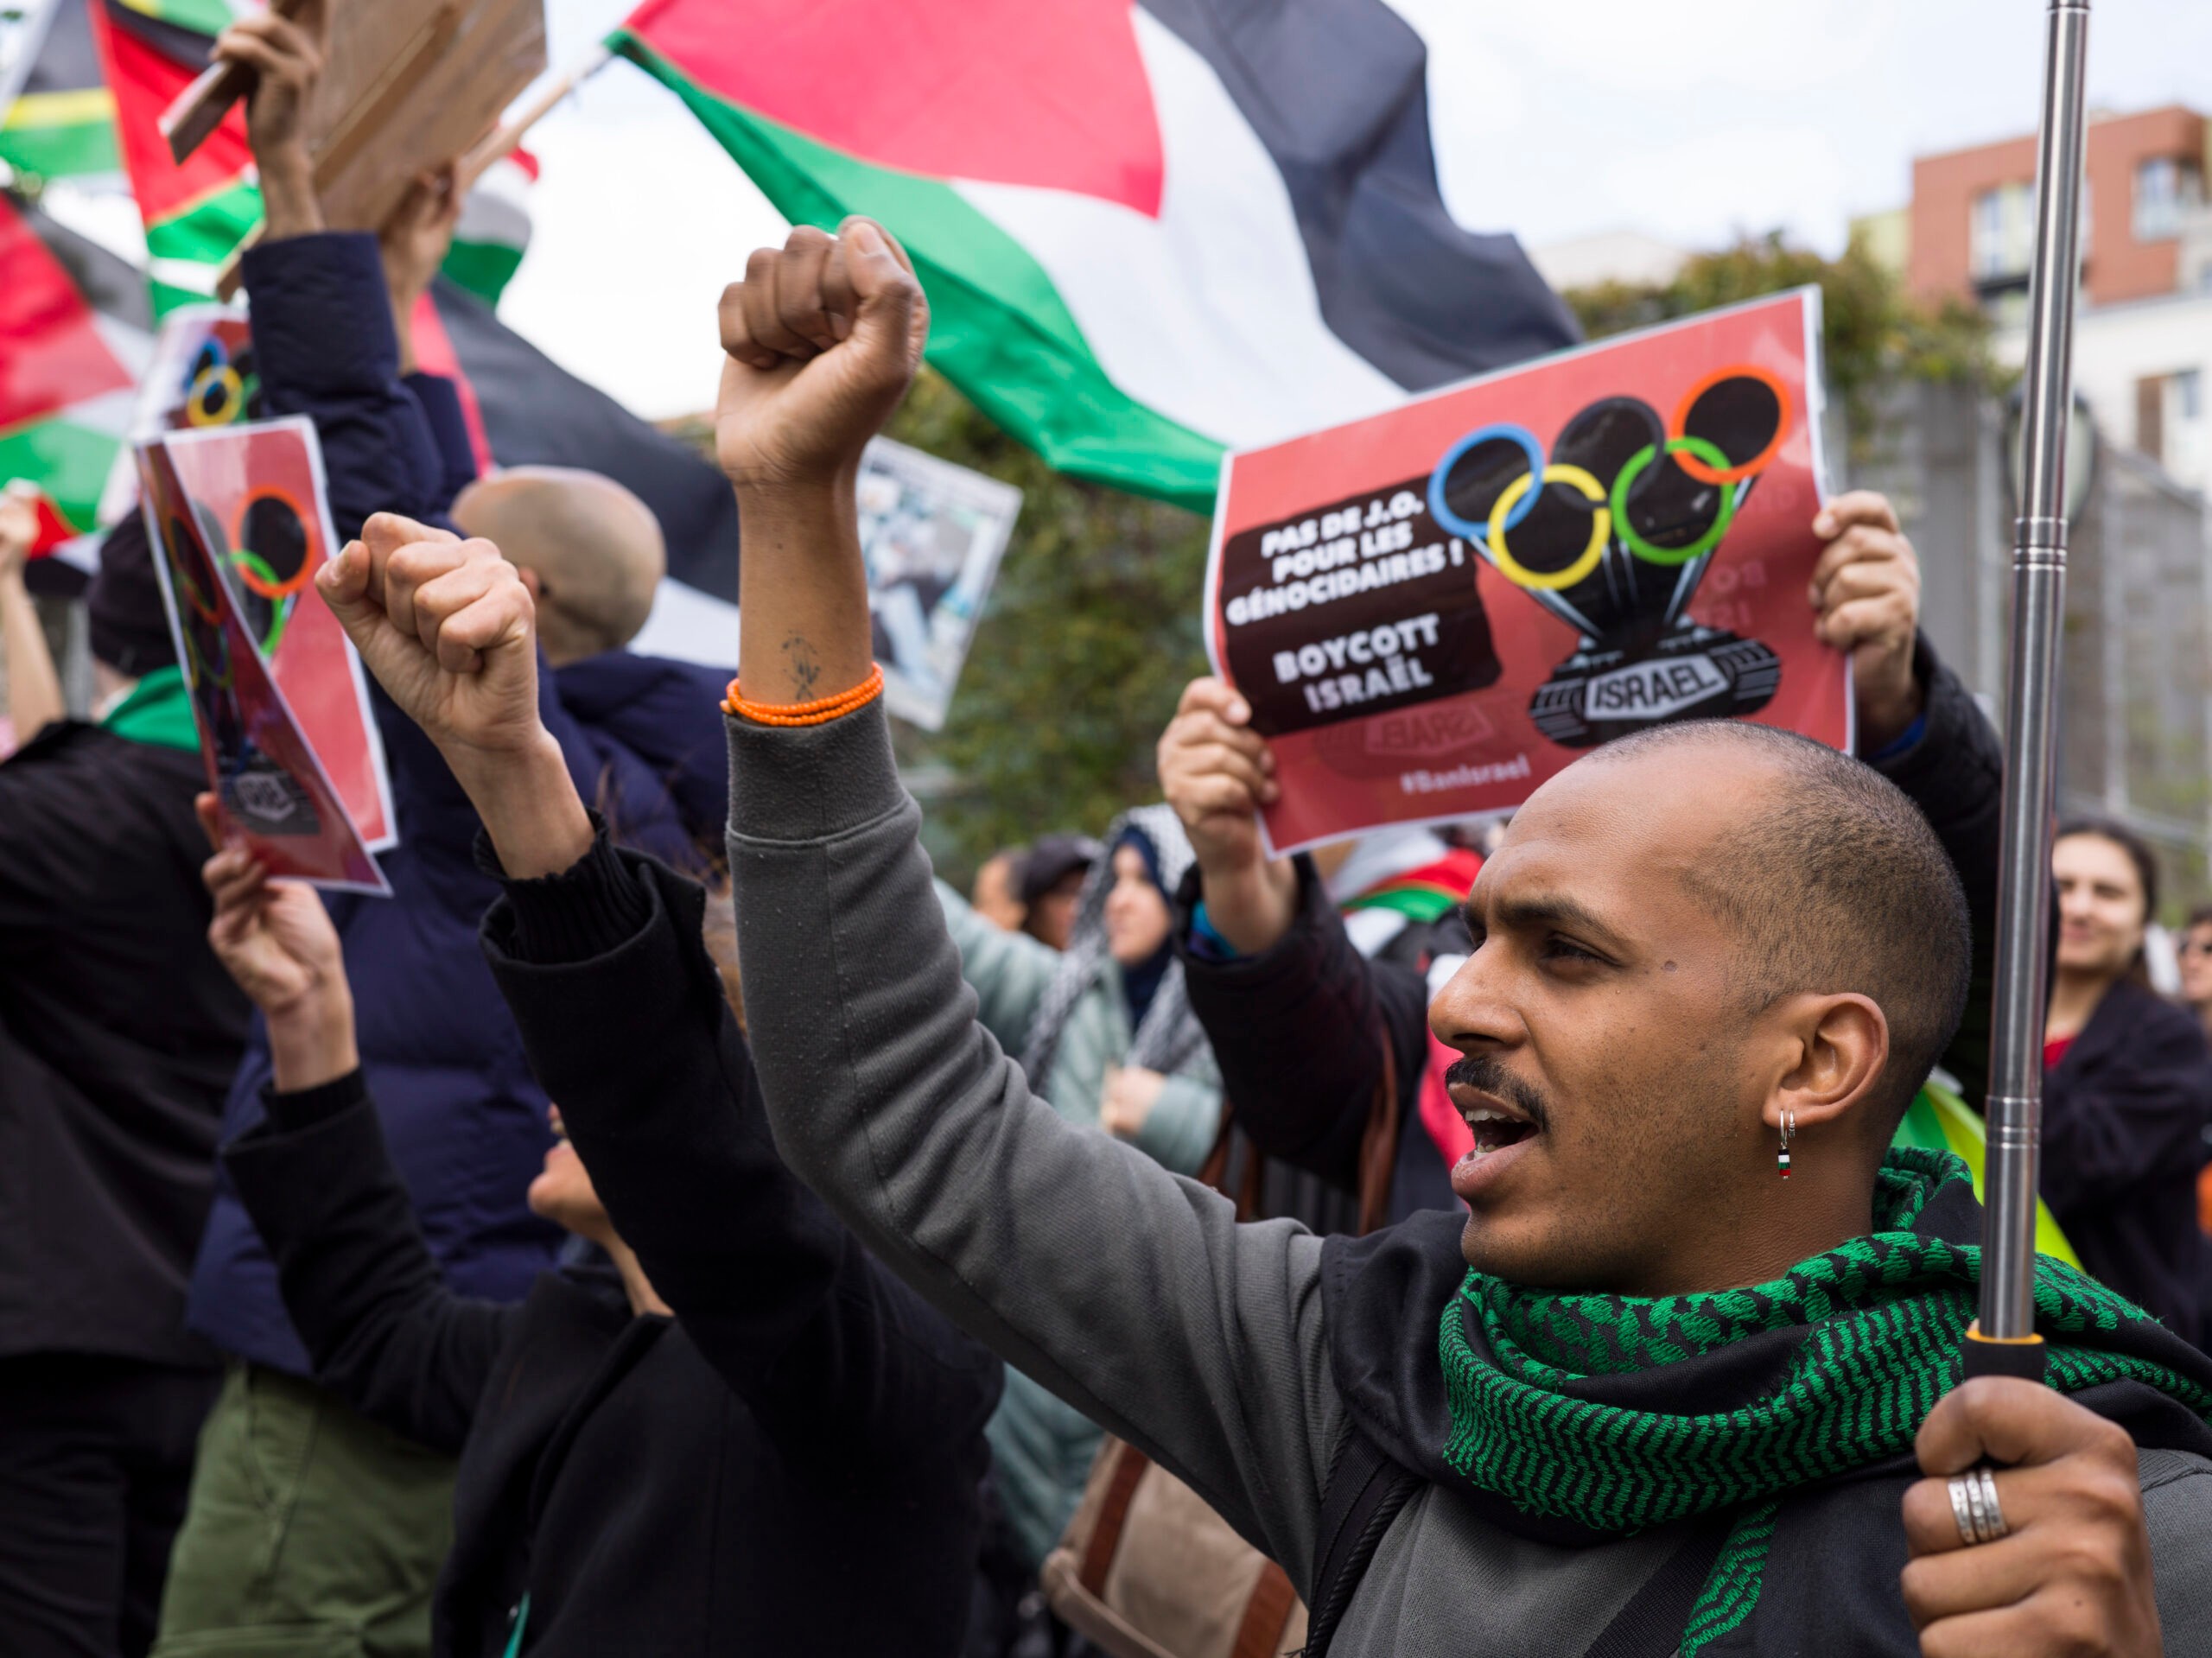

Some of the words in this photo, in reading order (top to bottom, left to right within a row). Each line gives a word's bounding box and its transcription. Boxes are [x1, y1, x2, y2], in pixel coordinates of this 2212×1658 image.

[1261, 518, 1319, 558] PAS
[1320, 505, 1363, 541] DE
[1363, 490, 1425, 528] J.O.
[1272, 537, 1357, 583] POUR
[1359, 520, 1414, 559] LES
[1225, 543, 1446, 626] GÉNOCIDAIRES
[1273, 613, 1440, 684] BOYCOTT
[1304, 653, 1433, 713] ISRAËL
[1593, 662, 1719, 711] ISRAEL
